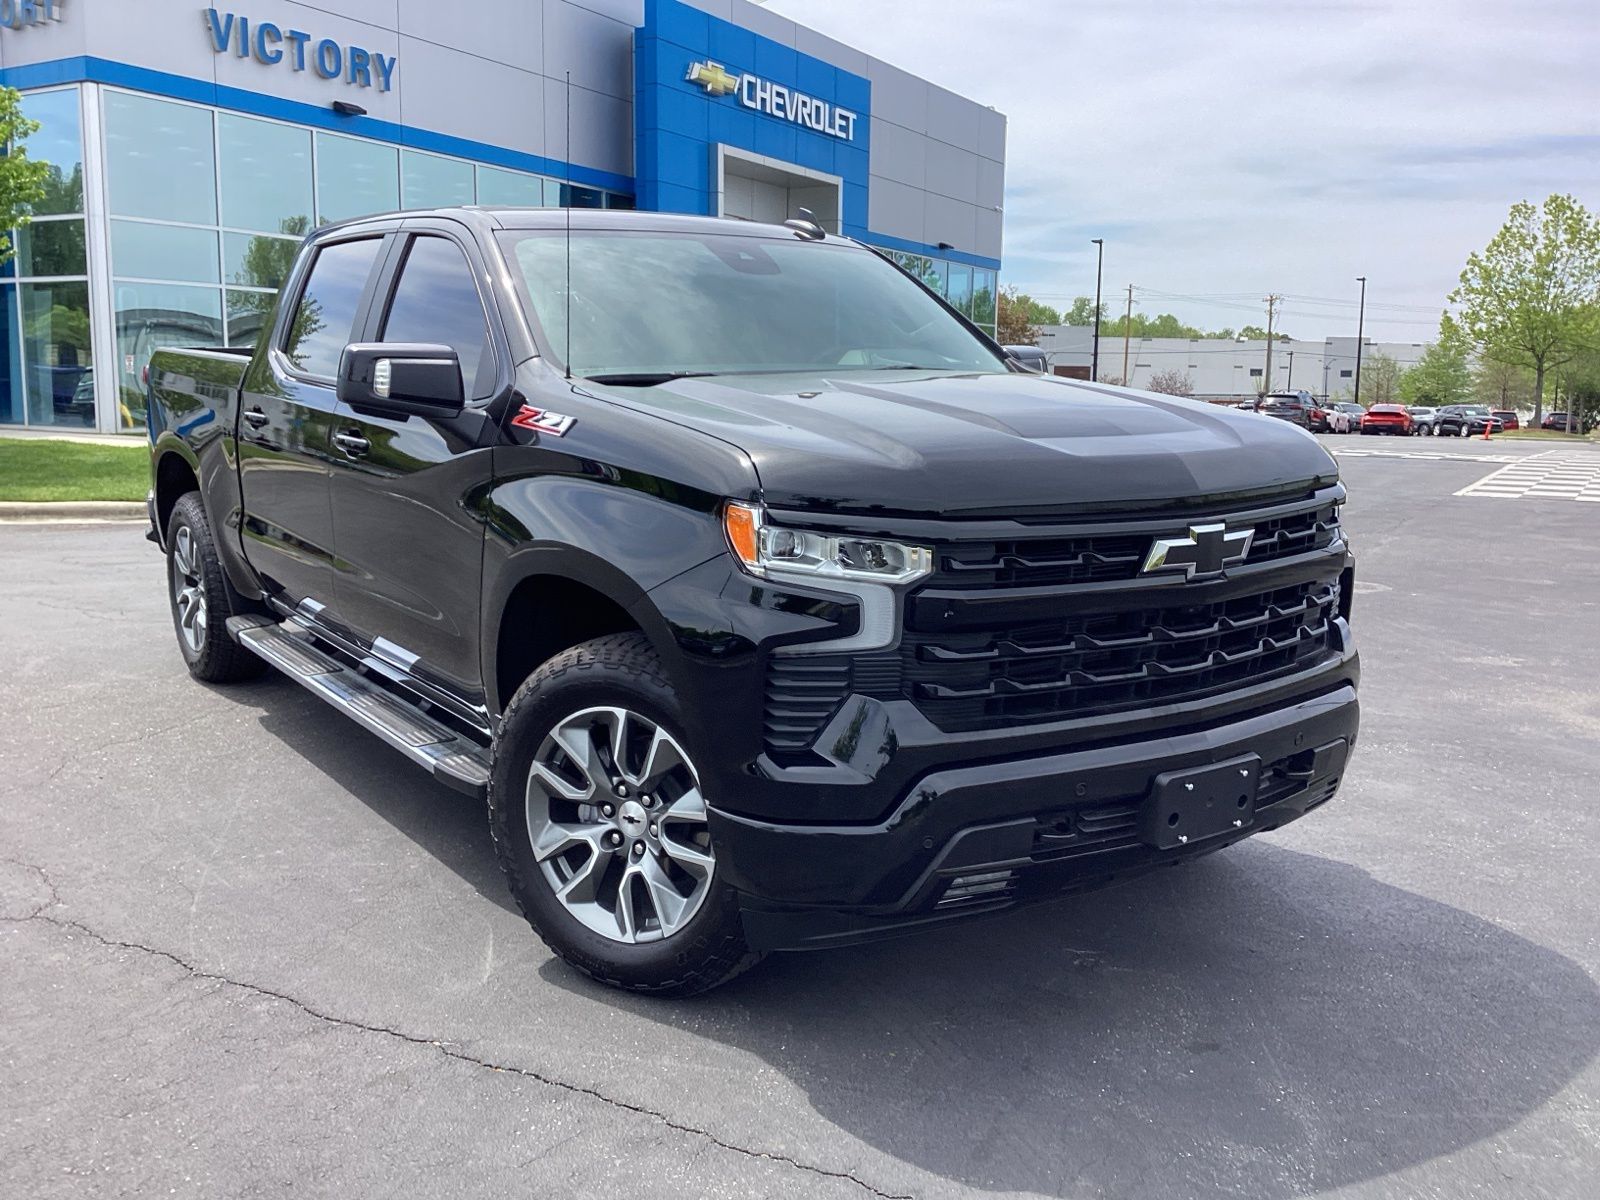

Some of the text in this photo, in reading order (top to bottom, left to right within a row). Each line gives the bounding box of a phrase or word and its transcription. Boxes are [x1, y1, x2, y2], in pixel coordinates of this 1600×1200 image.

[205, 8, 396, 92] VICTORY
[741, 73, 857, 141] CHEVROLET
[511, 404, 578, 437] Z71
